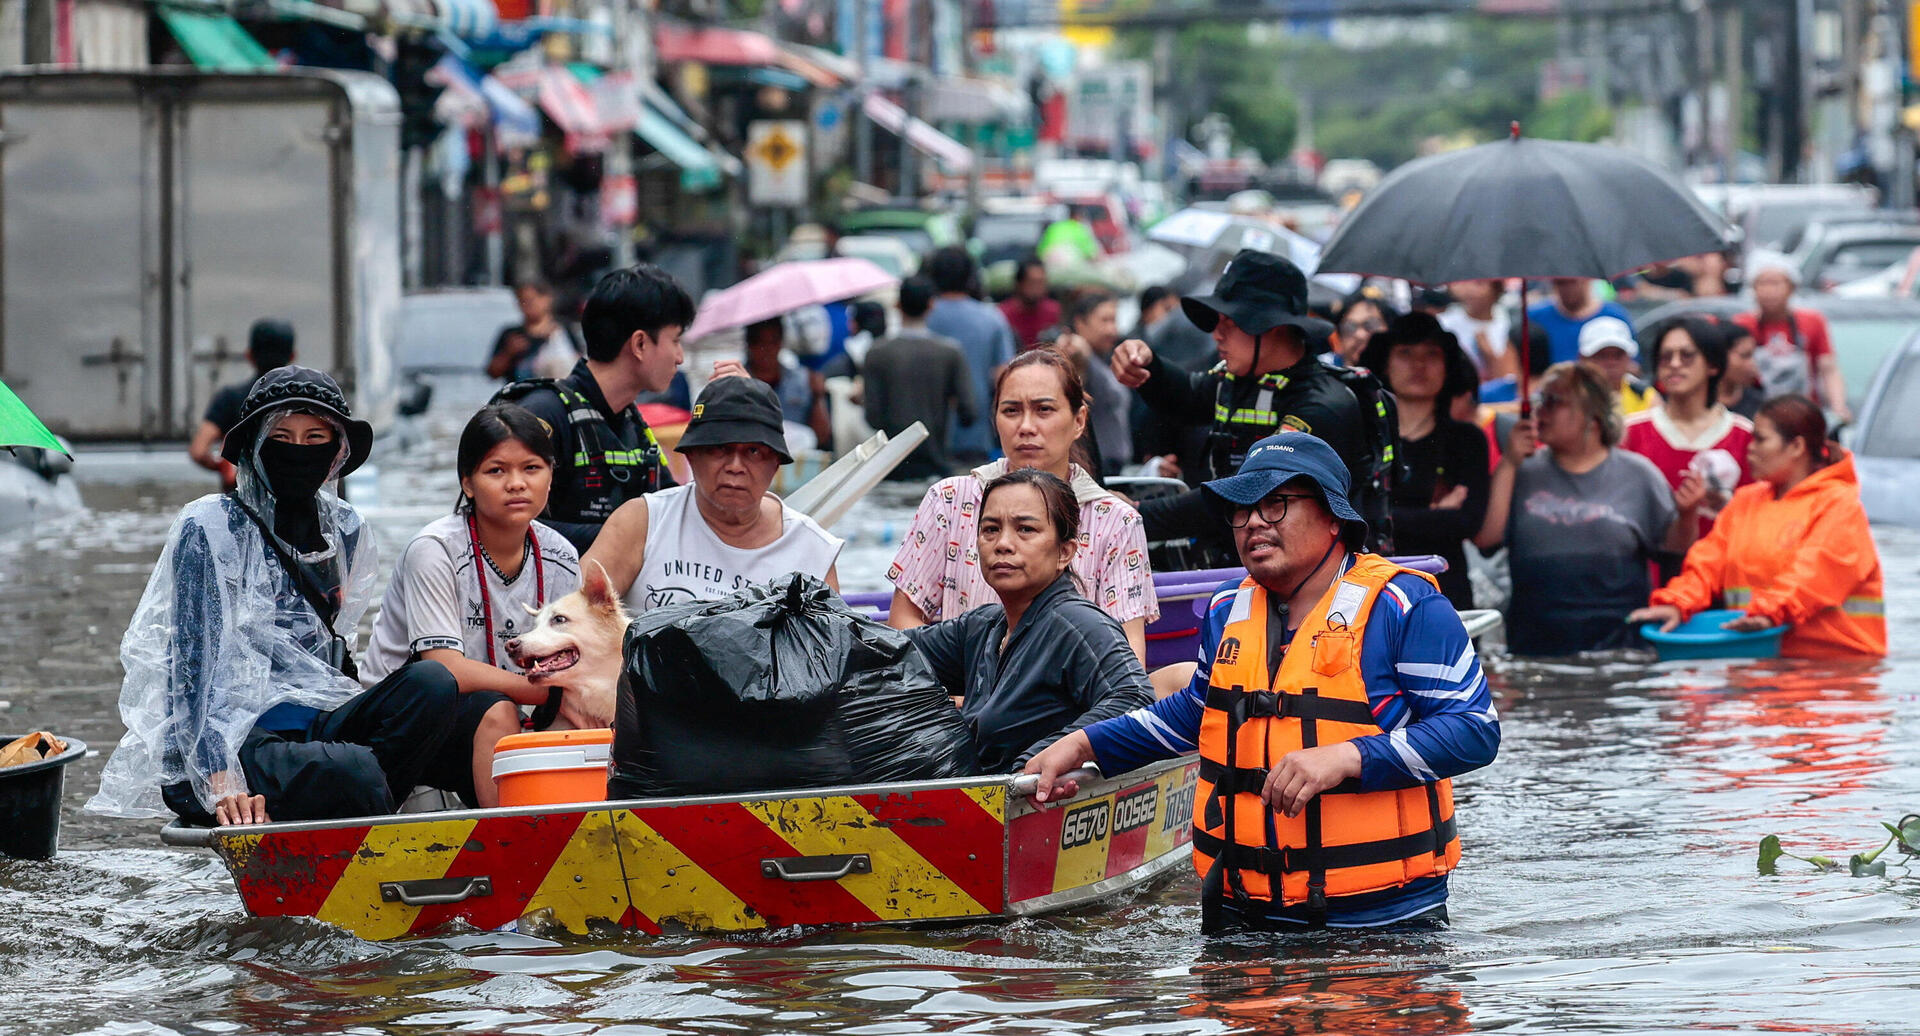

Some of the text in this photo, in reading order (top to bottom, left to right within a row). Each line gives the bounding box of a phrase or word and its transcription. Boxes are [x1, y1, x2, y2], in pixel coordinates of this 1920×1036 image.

[1266, 445, 1295, 453] TADANO
[664, 560, 723, 583] UNITED
[1062, 802, 1109, 847] 6670
[1113, 788, 1158, 833] 00562
